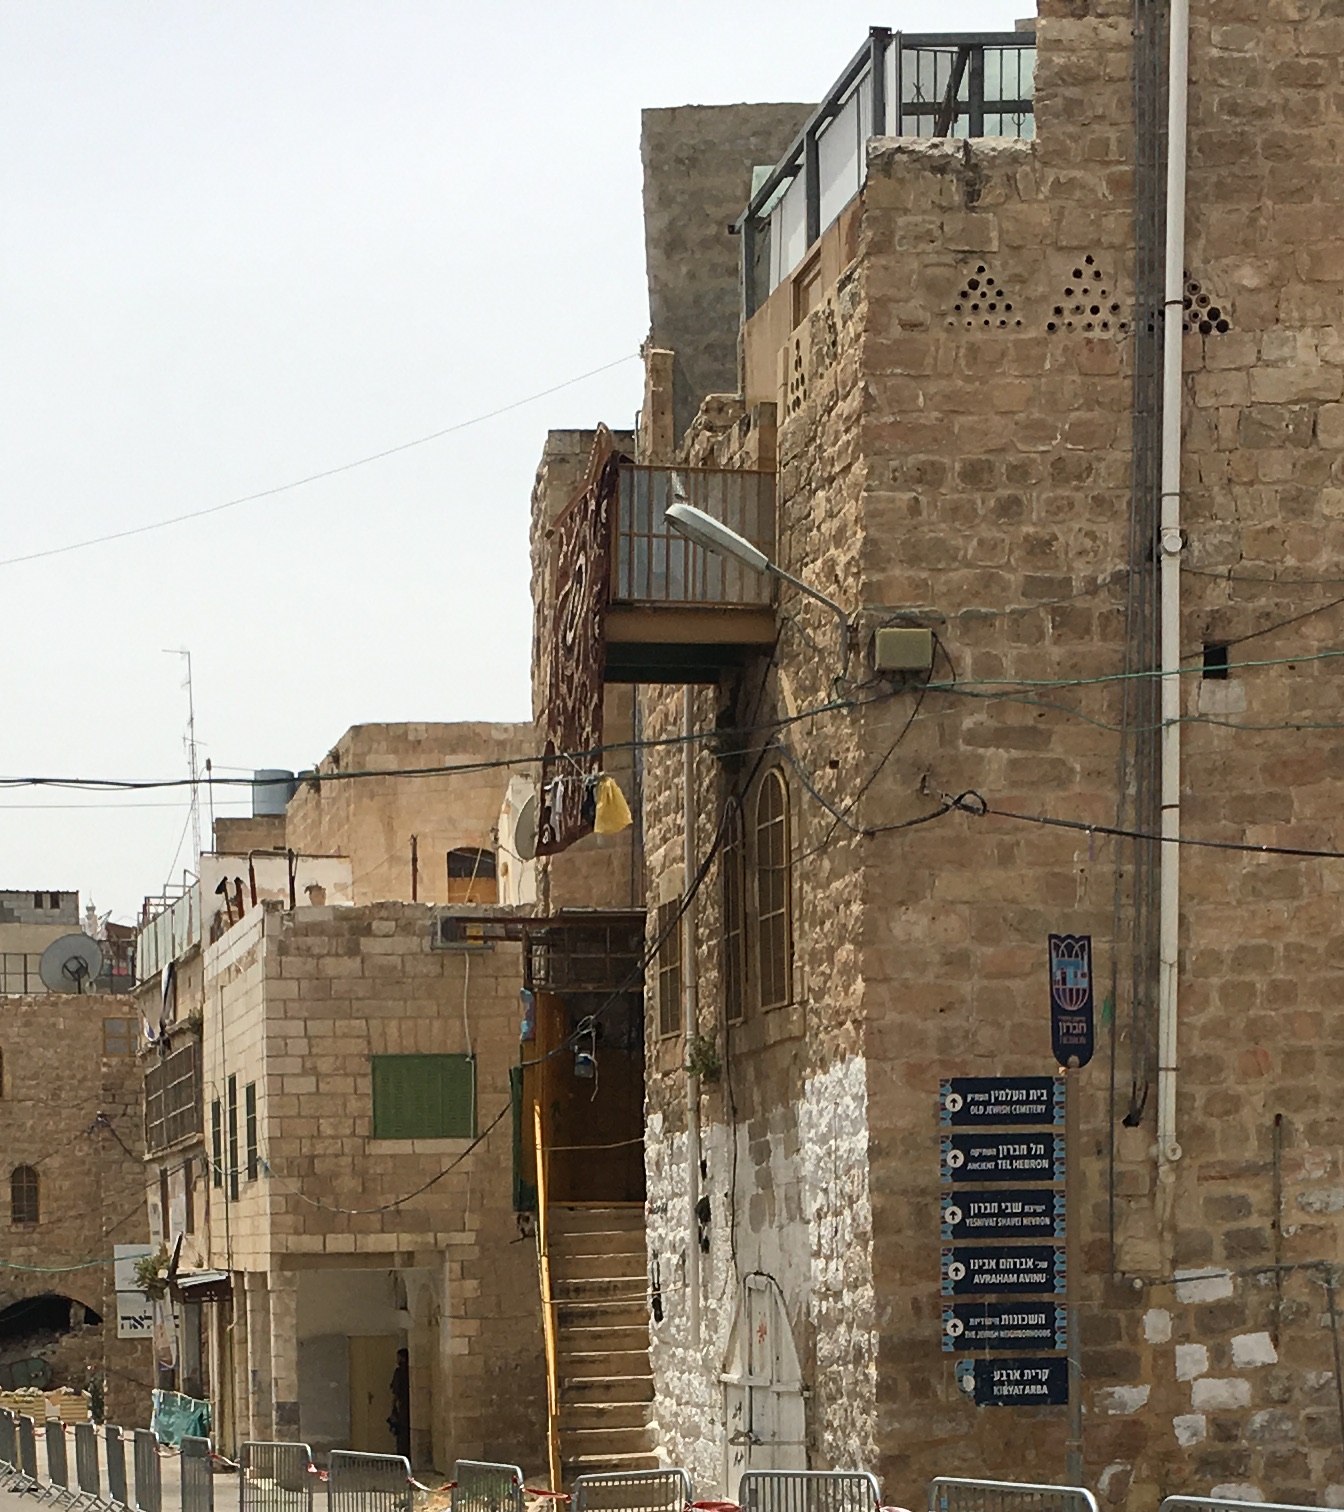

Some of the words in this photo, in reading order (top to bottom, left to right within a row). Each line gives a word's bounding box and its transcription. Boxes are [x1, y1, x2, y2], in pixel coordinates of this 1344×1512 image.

[1059, 1021, 1087, 1036] חברון
[990, 1088, 1026, 1104] העלמין
[1029, 1089, 1048, 1101] בית
[970, 1105, 984, 1115] OLD
[985, 1105, 1011, 1115] JEWISH
[1011, 1104, 1046, 1114] CEMETERY
[998, 1144, 1028, 1158] חברון
[1030, 1142, 1045, 1156] תל
[967, 1161, 996, 1170] ANCIENT
[997, 1159, 1012, 1170] TEL
[1012, 1158, 1049, 1169] HEBRON
[969, 1202, 999, 1216] חברון
[1001, 1202, 1022, 1214] שבי
[965, 1217, 997, 1227] YESHIVAT
[1022, 1216, 1051, 1226] HEVRON
[969, 1259, 997, 1270] אבינו
[999, 1258, 1034, 1269] אברהם
[973, 1273, 1018, 1284] AVRAHAM
[1018, 1273, 1047, 1283] AVINU
[1000, 1313, 1046, 1325] השכונות
[993, 1369, 1021, 1382] ארבע
[1023, 1368, 1050, 1382] קרית
[993, 1384, 1024, 1396] KIRYAT
[1024, 1384, 1049, 1395] ARBA
